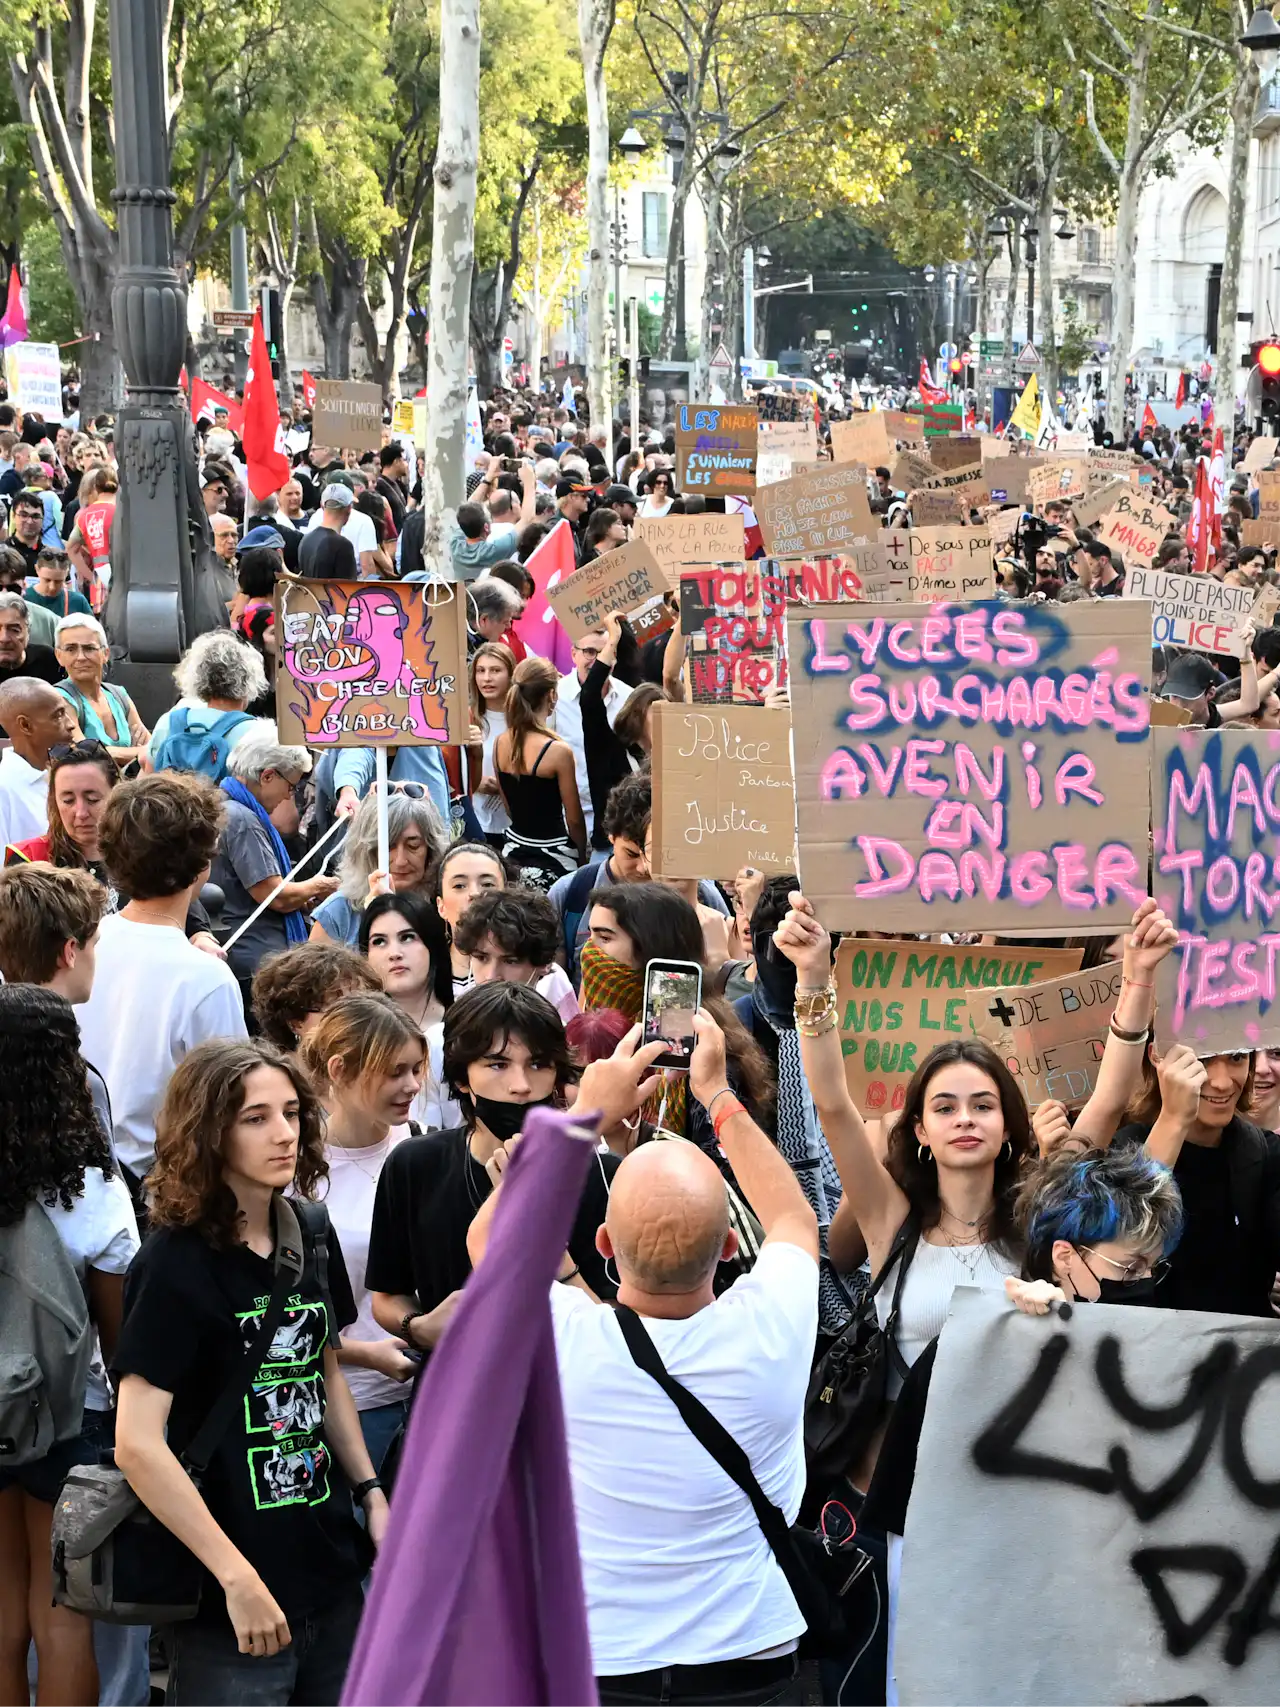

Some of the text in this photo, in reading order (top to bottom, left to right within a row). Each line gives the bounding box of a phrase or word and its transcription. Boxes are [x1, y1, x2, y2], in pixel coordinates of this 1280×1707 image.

[680, 406, 721, 431] LES
[686, 469, 711, 485] LES
[679, 523, 696, 539] LA
[703, 522, 729, 536] RUE
[909, 536, 930, 556] De
[936, 539, 964, 550] sous
[970, 538, 992, 557] pour
[682, 541, 745, 555] LA POLICE
[856, 552, 877, 572] LES
[887, 559, 909, 570] nos
[680, 570, 787, 616] TOUS
[962, 577, 990, 593] pour
[1130, 571, 1180, 600] PLUS
[1184, 580, 1207, 604] DE
[1207, 584, 1252, 614] PASTIS
[584, 581, 654, 627] EN DANGER
[639, 609, 663, 629] DES
[1152, 600, 1217, 623] MOINS DE
[284, 612, 345, 643] EAT
[808, 602, 1042, 672] LYCÉES
[1153, 615, 1233, 653] OLICE
[294, 646, 362, 677] GOV
[316, 675, 456, 702] CHIE LEUR
[845, 647, 1152, 733] SURCHARGÉS
[679, 713, 773, 764] Police
[739, 770, 793, 787] Partou
[684, 800, 769, 845] Justice
[926, 800, 1005, 851] EN
[853, 834, 1152, 909] DANGER
[852, 950, 1044, 989] ON MANQUE
[842, 998, 904, 1034] NOS
[1012, 993, 1049, 1026] DE
[1059, 975, 1122, 1014] BUDG
[842, 1038, 917, 1073] POUR
